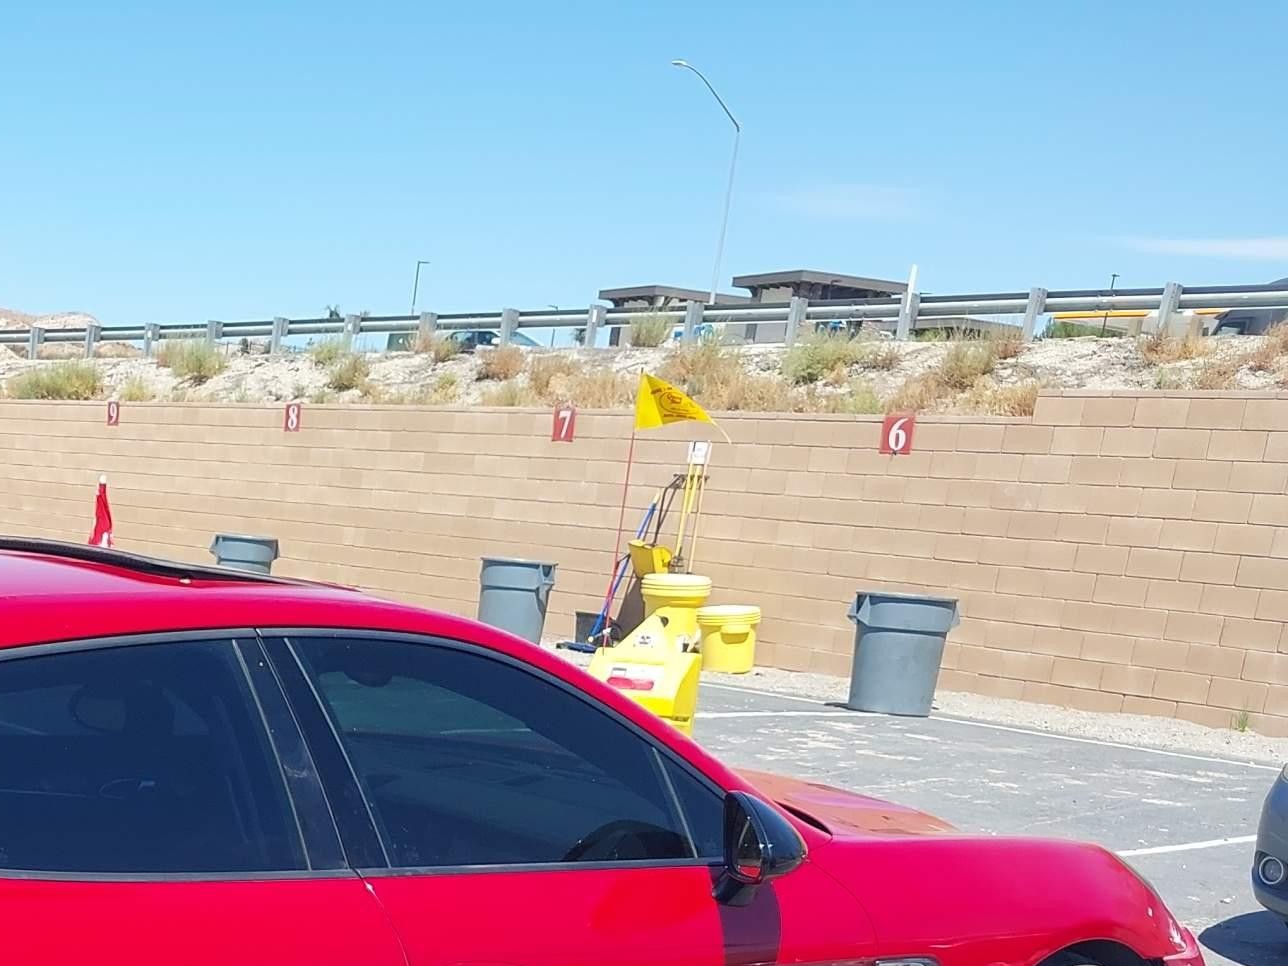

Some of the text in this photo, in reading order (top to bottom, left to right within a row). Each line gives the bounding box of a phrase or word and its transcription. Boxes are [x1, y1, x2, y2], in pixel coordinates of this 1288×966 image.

[109, 403, 119, 424] 9
[288, 405, 298, 430] 8
[558, 410, 572, 439] 7
[888, 417, 909, 451] 6
